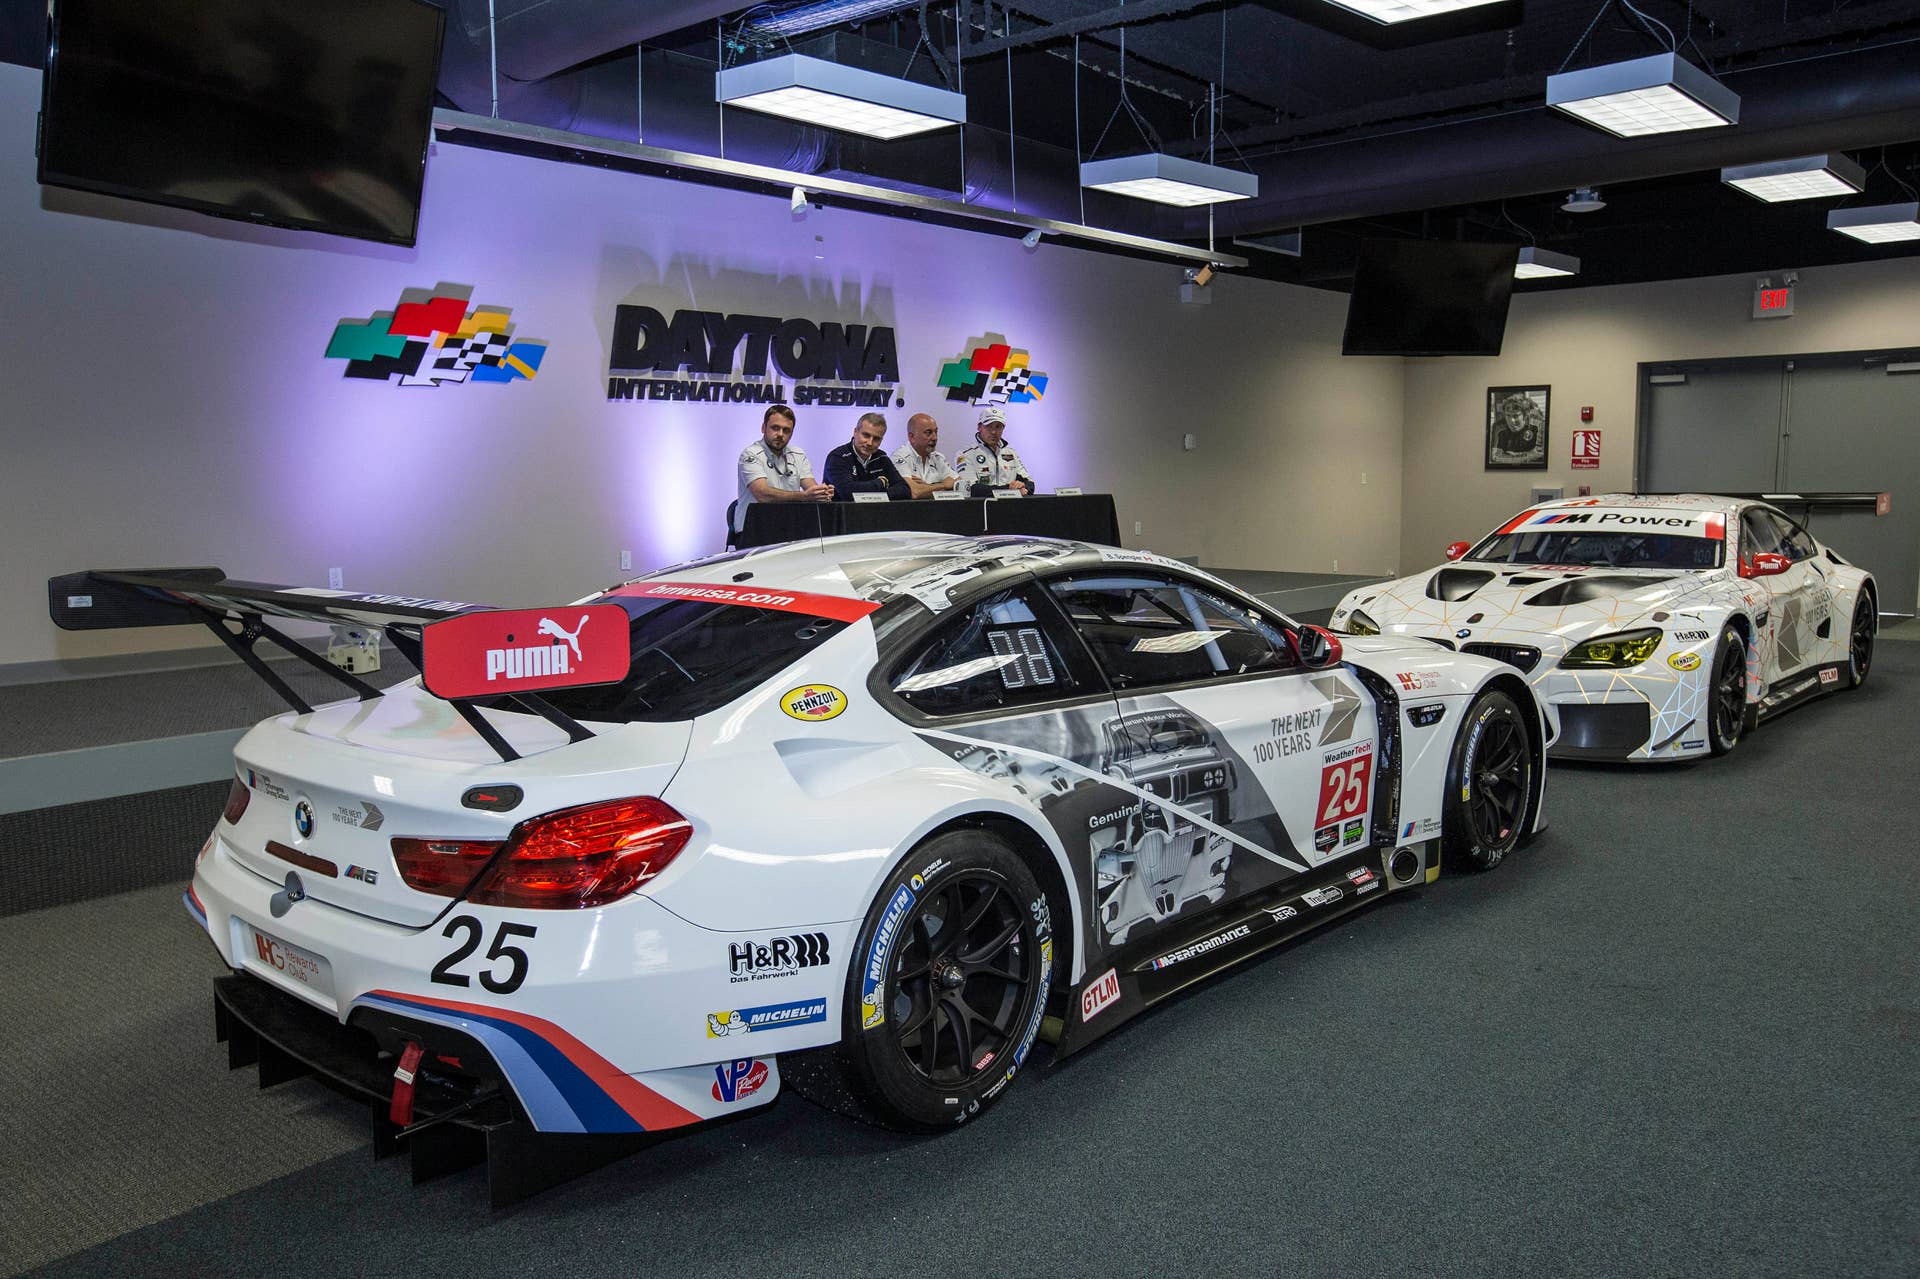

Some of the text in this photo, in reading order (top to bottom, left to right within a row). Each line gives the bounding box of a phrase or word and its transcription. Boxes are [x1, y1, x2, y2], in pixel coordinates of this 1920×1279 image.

[1760, 289, 1788, 309] EXIT
[609, 304, 900, 383] DAYTONA
[607, 377, 787, 405] INTERNATIONAL
[1599, 513, 1698, 528] Power
[649, 584, 796, 608] bmwusa.com
[486, 644, 568, 681] PUMA
[790, 690, 839, 716] PENNZOIL
[1271, 708, 1322, 737] THE NEXT
[1253, 733, 1312, 764] 100 YEARS
[1324, 742, 1372, 765] WeatherTech
[1464, 723, 1481, 778] MICHELIN
[1322, 760, 1366, 821] 25
[1089, 804, 1140, 828] Genuine
[1272, 906, 1297, 923] AERO
[870, 890, 909, 982] MICHELIN
[255, 933, 319, 974] IHG Rewards
[430, 915, 538, 995] 25
[730, 938, 796, 975] H&R
[730, 969, 799, 984] Das Fahrwerk!
[1083, 975, 1119, 1015] GTLM
[750, 1004, 825, 1024] MICHELIN
[975, 1053, 995, 1071] BBS
[715, 1056, 769, 1102] VP Racing
